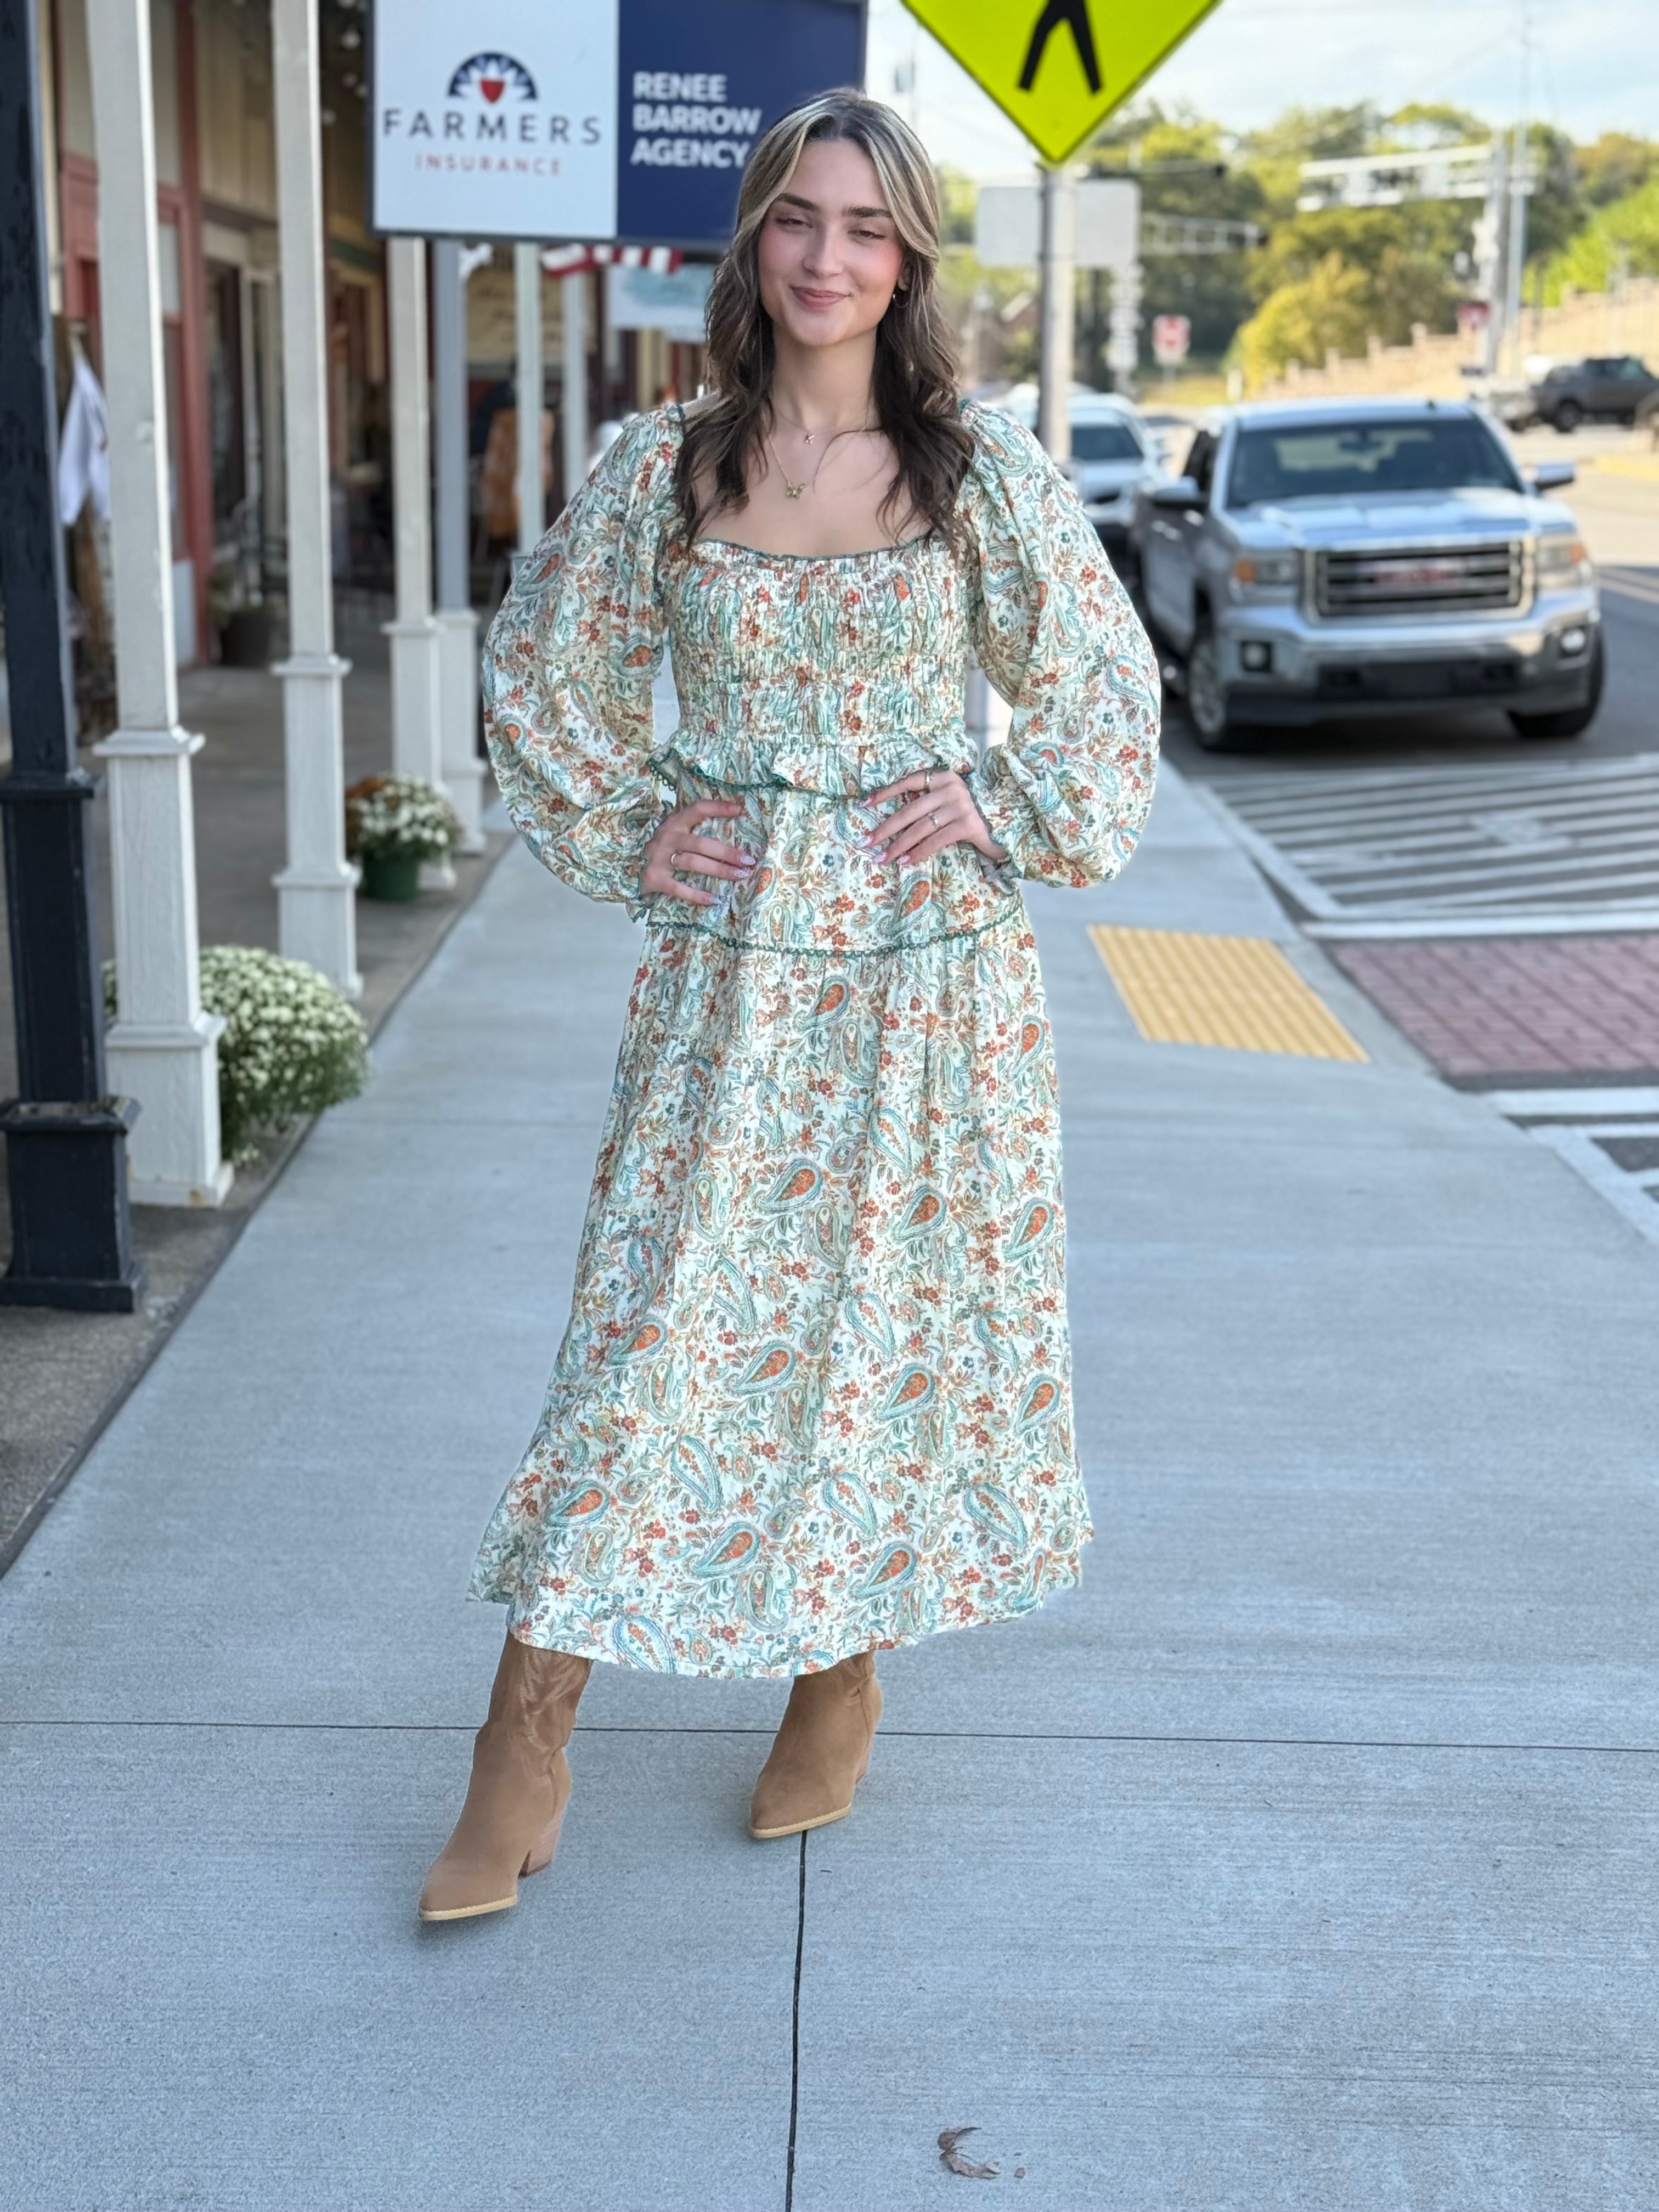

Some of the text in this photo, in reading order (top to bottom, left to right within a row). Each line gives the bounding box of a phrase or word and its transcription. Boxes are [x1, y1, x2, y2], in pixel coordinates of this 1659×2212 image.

[633, 71, 727, 103] RENEE
[382, 108, 602, 145] FARMERS
[633, 103, 761, 134] BARROW
[415, 150, 562, 176] INSURANCE
[630, 137, 750, 168] AGENCY
